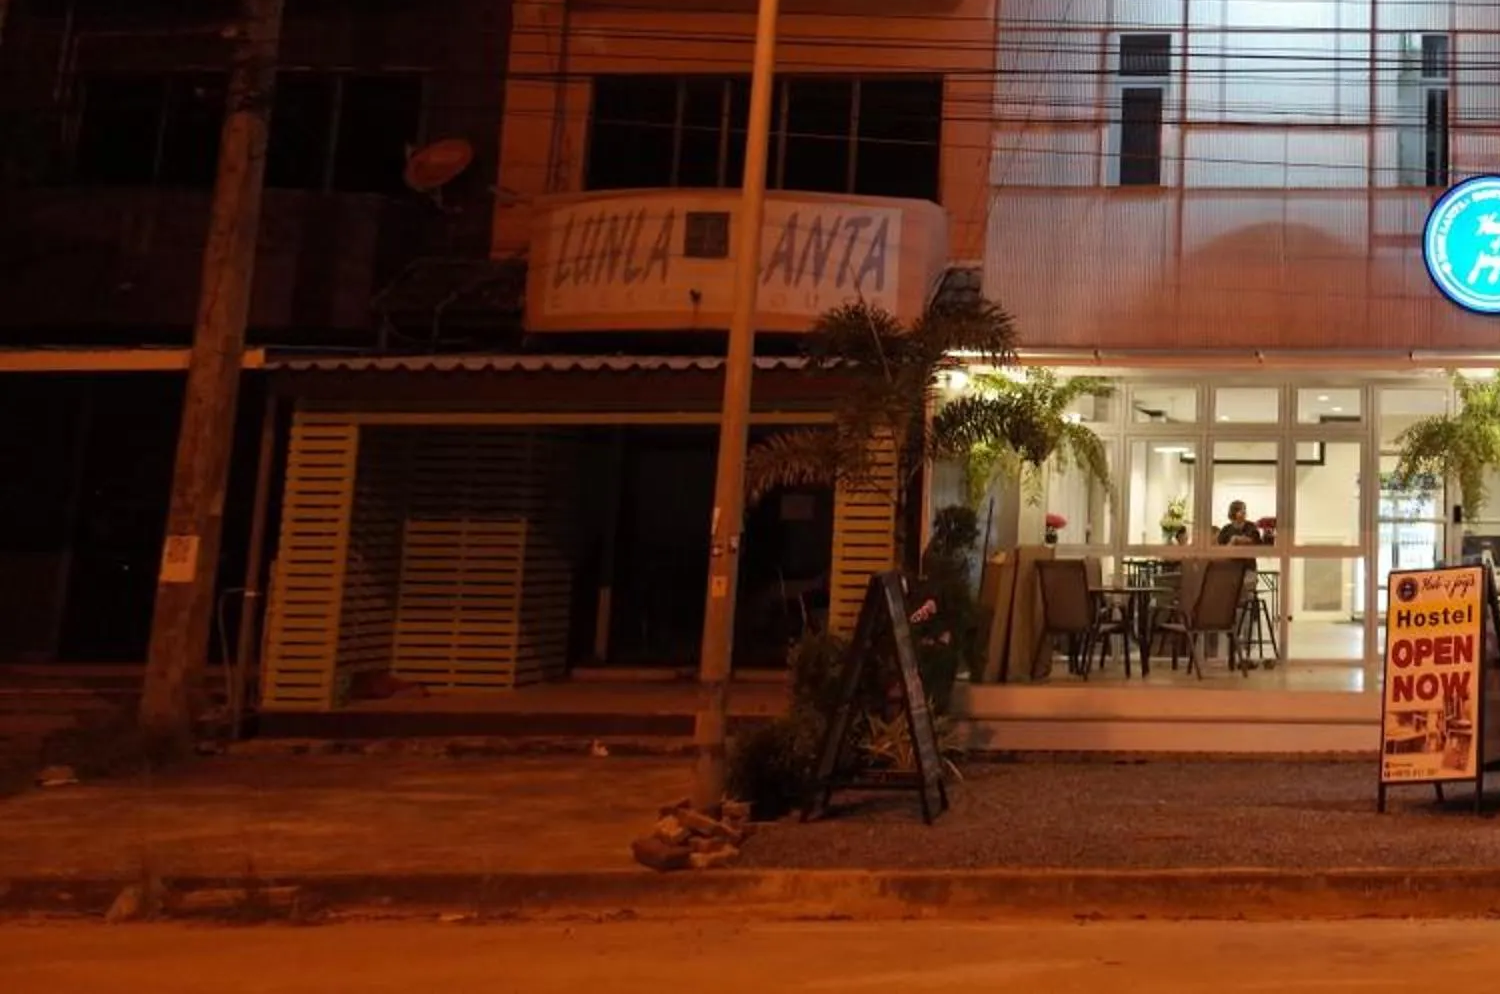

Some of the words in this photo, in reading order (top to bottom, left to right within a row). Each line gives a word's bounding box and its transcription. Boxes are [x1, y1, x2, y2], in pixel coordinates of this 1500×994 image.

[757, 209, 889, 293] ANTA
[1397, 605, 1473, 628] Hostel
[1392, 634, 1473, 669] OPEN
[1392, 671, 1471, 703] NOW
